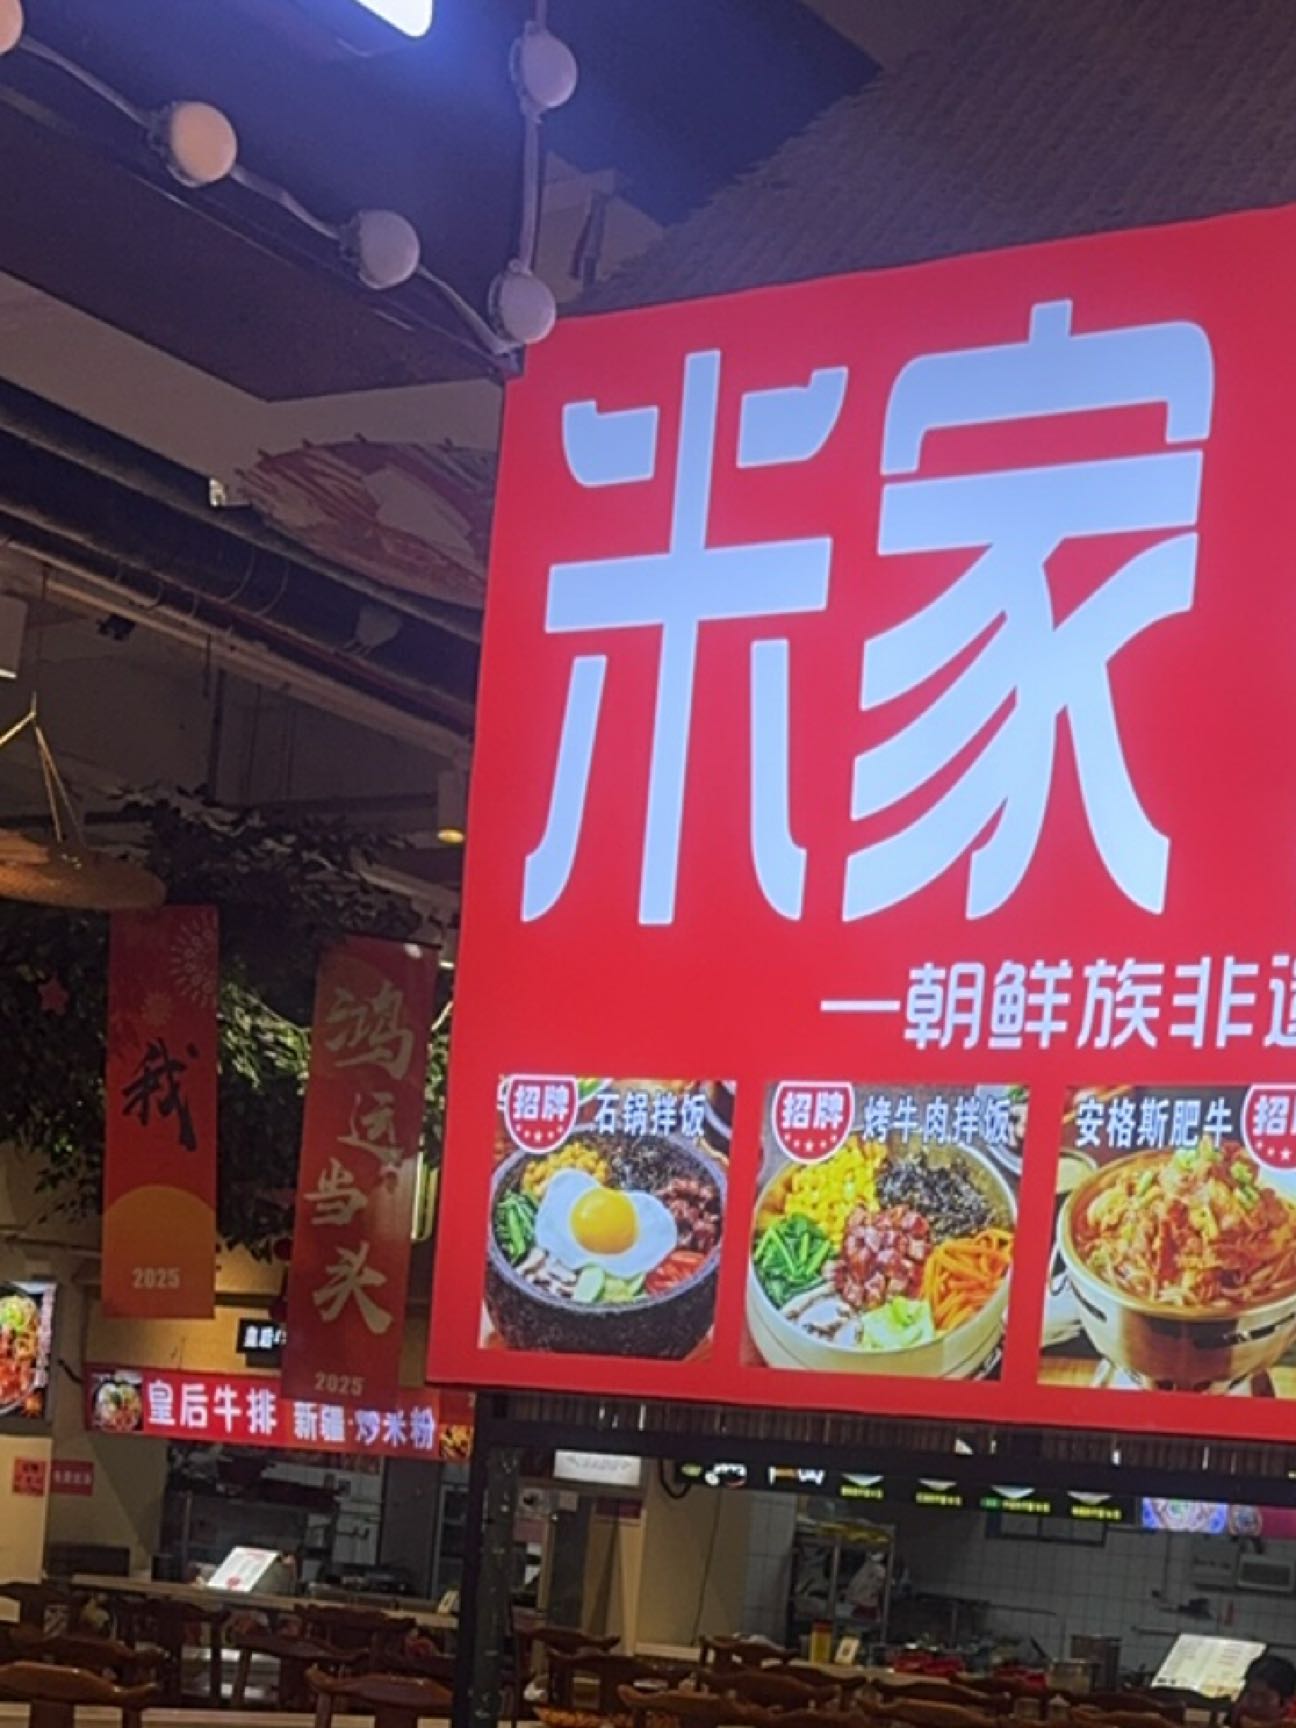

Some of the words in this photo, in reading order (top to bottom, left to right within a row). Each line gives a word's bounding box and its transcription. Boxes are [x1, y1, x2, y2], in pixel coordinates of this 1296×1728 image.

[512, 1083, 569, 1122] 招牌
[595, 1091, 706, 1137] 石锅拌饭
[783, 1090, 844, 1130] 招牌
[862, 1095, 1010, 1145] 烤牛肉拌饭
[1074, 1097, 1234, 1151] 安格斯肥牛
[303, 985, 414, 1334] 鸿运当头
[132, 1267, 181, 1290] 2025
[314, 1371, 364, 1397] 2025
[148, 1379, 278, 1436] 皇后牛排
